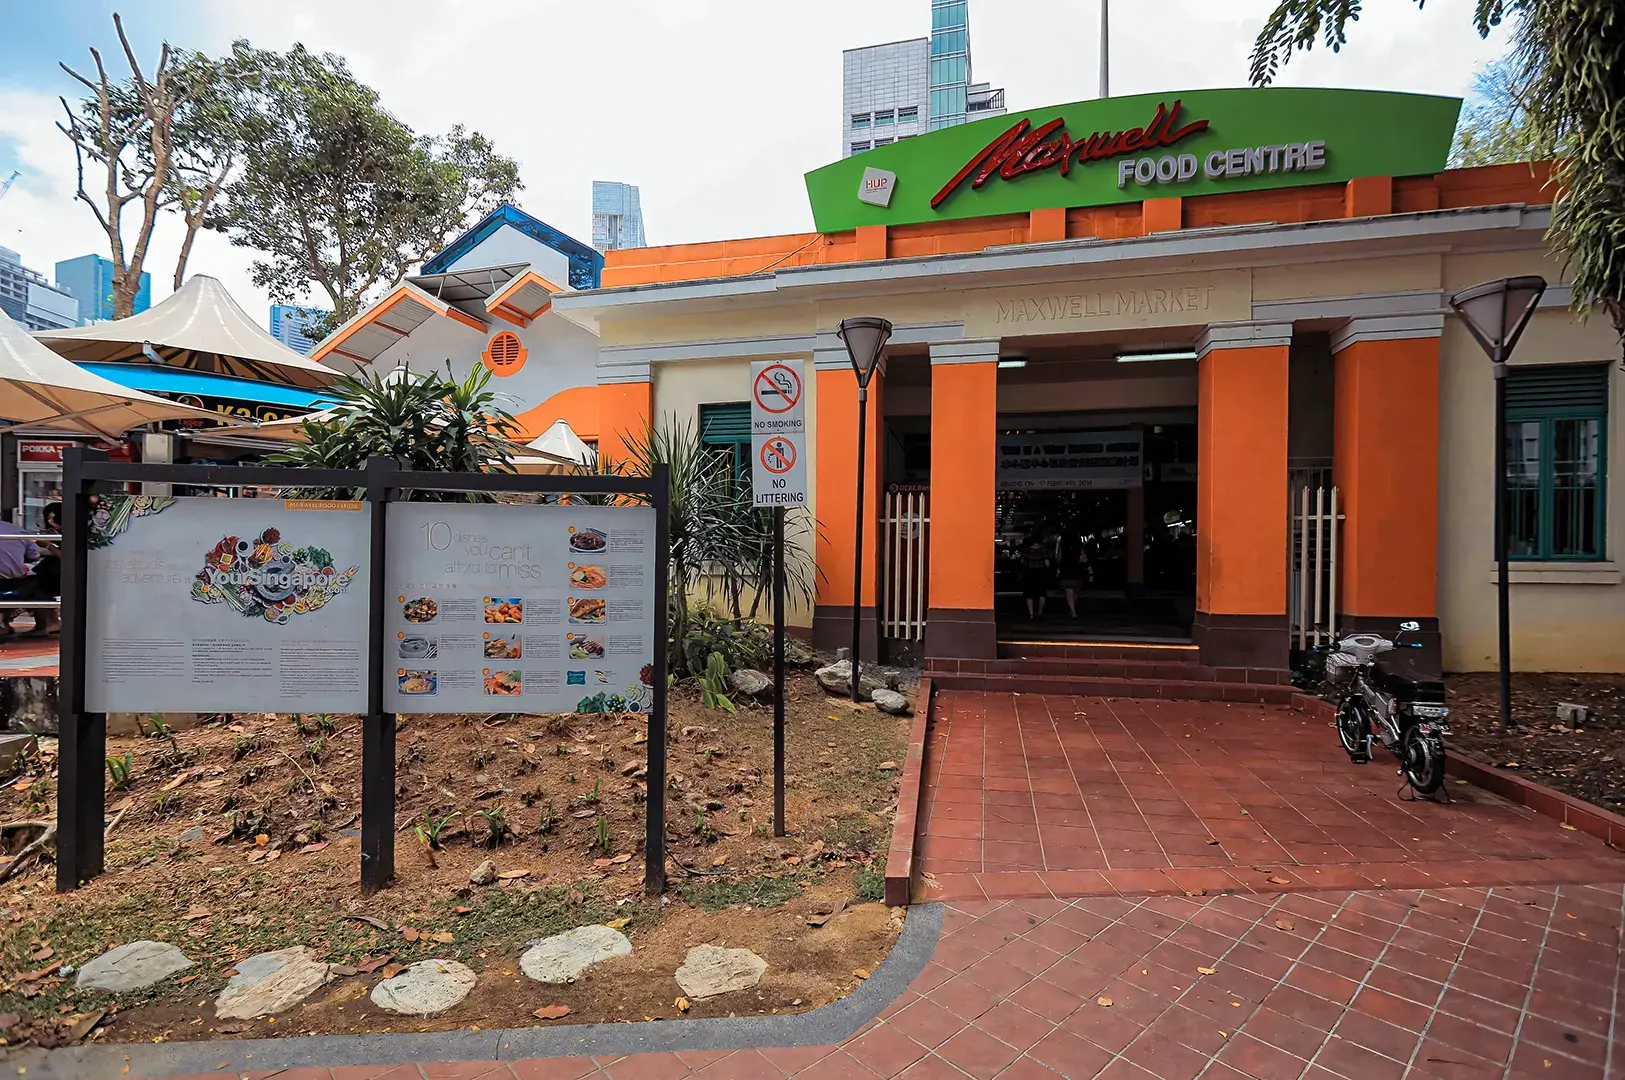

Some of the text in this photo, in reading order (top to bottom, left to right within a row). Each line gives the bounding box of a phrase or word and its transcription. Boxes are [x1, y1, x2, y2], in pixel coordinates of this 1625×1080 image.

[930, 99, 1210, 210] Maxwell
[1118, 140, 1325, 187] FOOD CENTRE
[995, 285, 1216, 323] MAXWELL MARKET
[754, 420, 803, 429] NO SMOKING
[22, 445, 56, 453] POKKA
[756, 478, 804, 504] NO LITTERING
[419, 520, 489, 551] 10 dishes
[465, 541, 534, 562] you can't
[206, 568, 350, 590] YourSingapore
[444, 561, 543, 580] afford to miss
